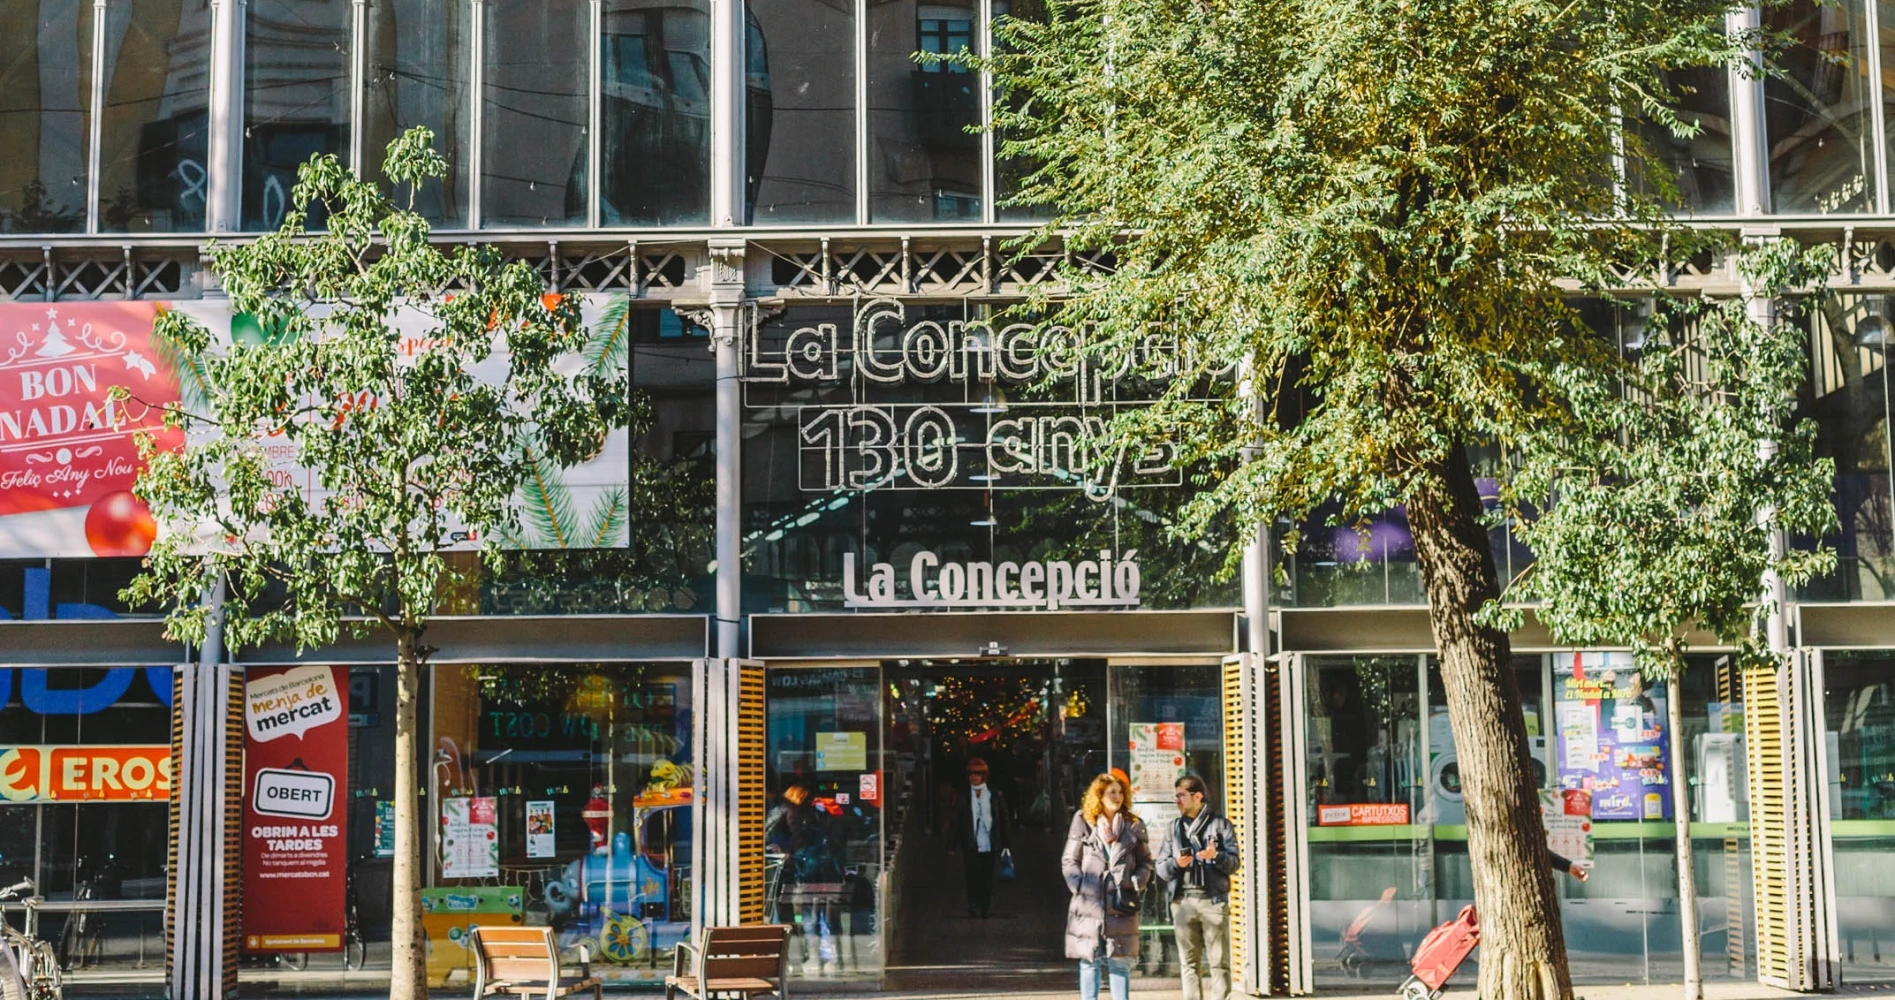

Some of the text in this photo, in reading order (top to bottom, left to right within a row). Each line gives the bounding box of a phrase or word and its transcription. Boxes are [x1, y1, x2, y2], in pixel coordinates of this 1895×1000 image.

[741, 302, 837, 381] La
[19, 364, 96, 400] BON
[0, 401, 126, 441] NADAL
[800, 406, 957, 489] 130
[0, 456, 133, 490] Feliç Any Nou
[843, 548, 1140, 610] La Concepció
[250, 673, 325, 700] Mercats de Barcelona
[252, 683, 328, 714] menja de
[256, 697, 332, 732] mercat
[267, 786, 322, 802] OBERT
[1351, 805, 1406, 817] CARTUTXOS
[251, 825, 338, 838] OBRIM A LES
[266, 839, 323, 851] TARDES
